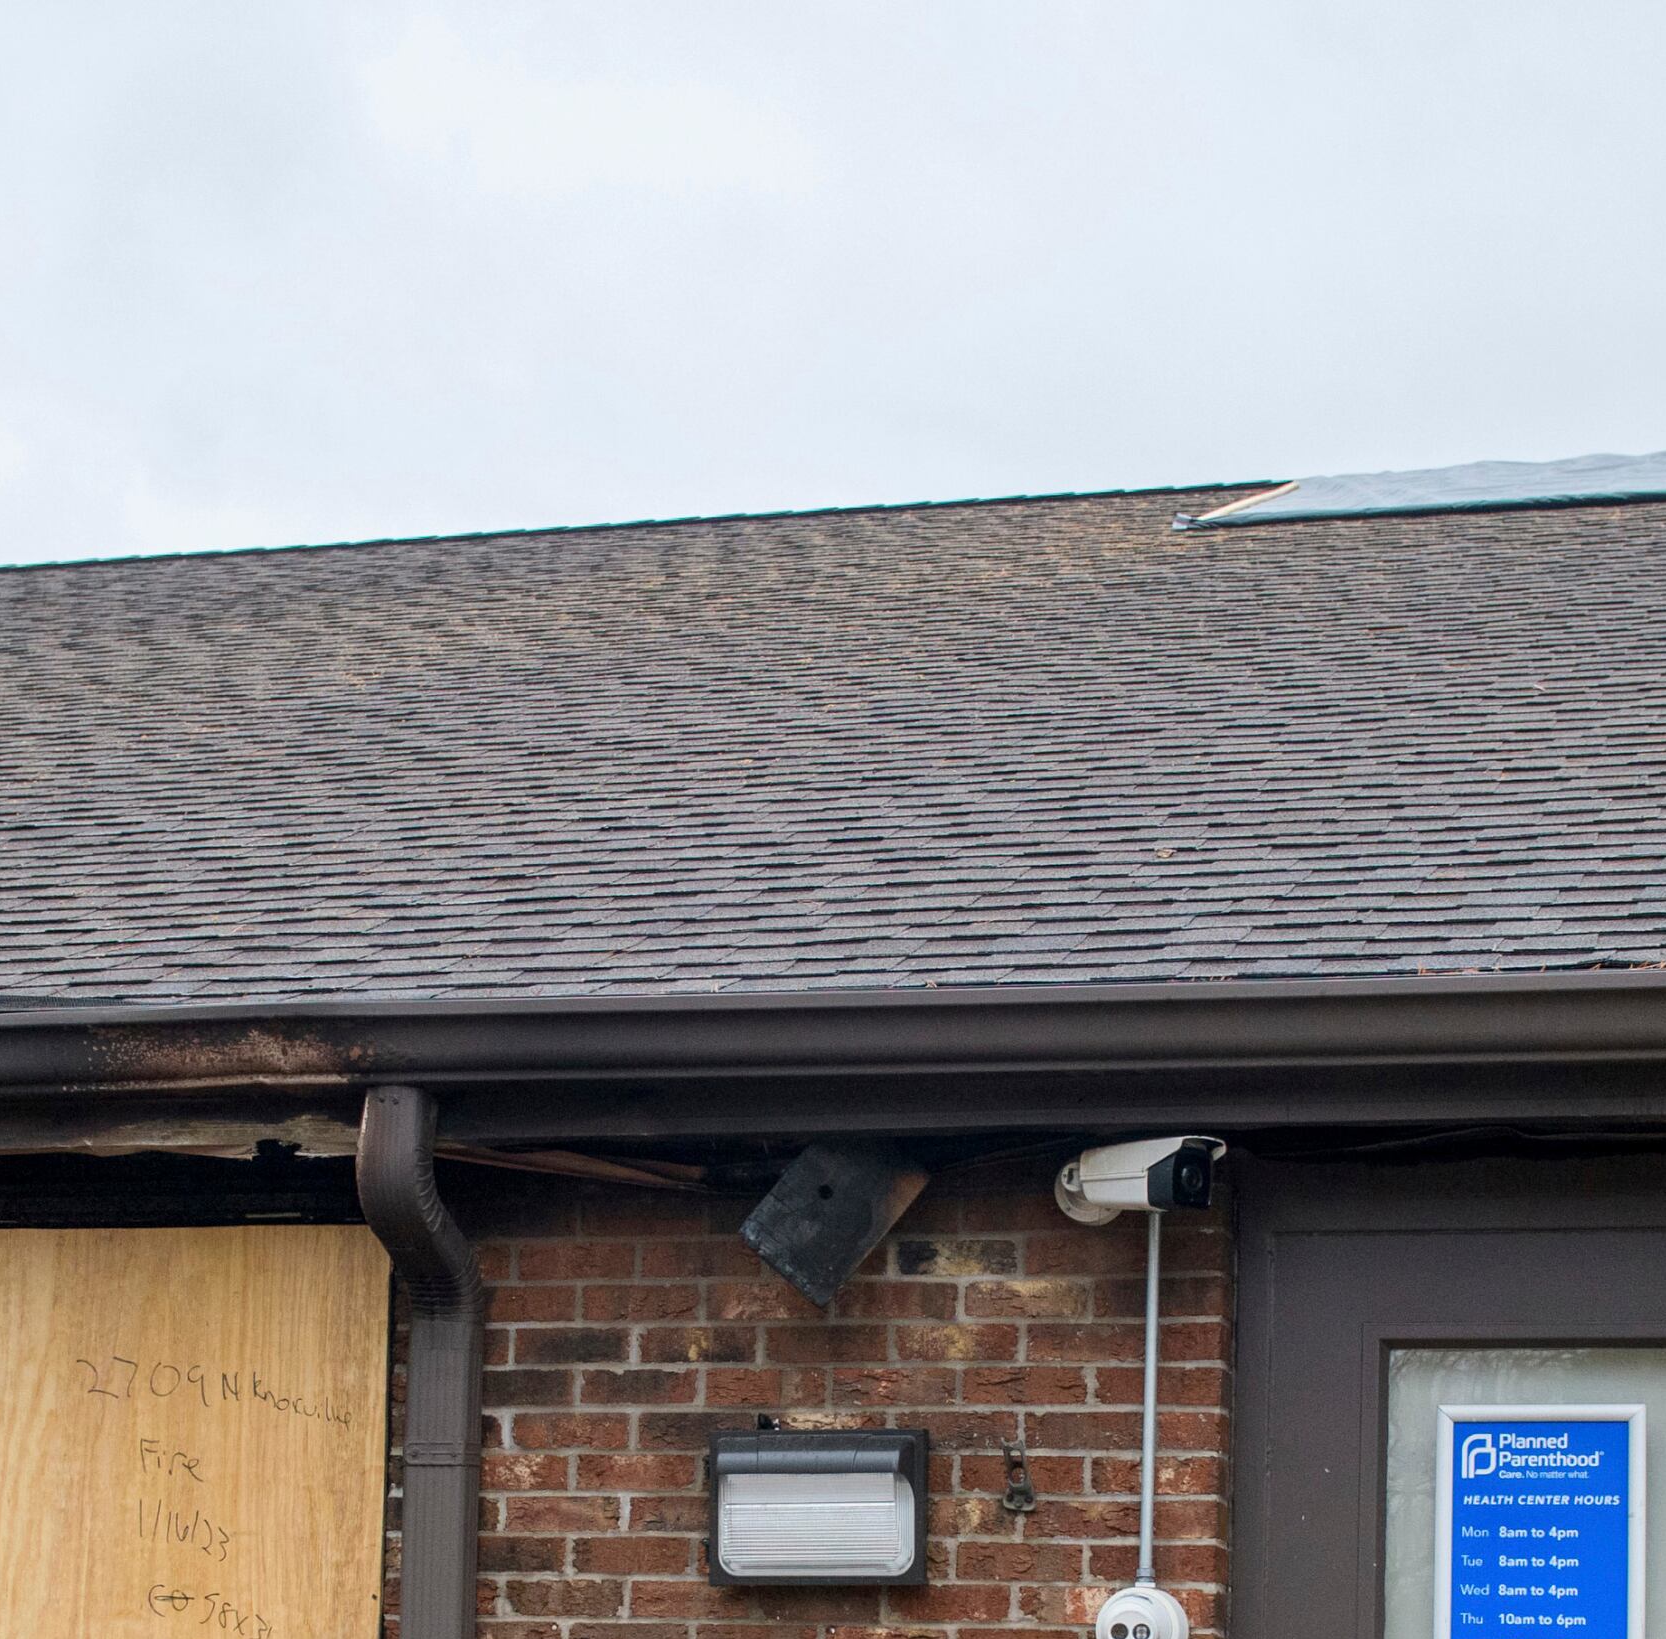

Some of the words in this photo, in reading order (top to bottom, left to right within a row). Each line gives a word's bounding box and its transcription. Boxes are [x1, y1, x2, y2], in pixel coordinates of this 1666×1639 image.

[76, 1355, 210, 1408] 2709
[221, 1371, 240, 1401] N
[1499, 1433, 1568, 1449] Planned
[140, 1438, 203, 1482] Fire
[1499, 1450, 1600, 1467] Parenthood
[1499, 1470, 1525, 1479] Care.
[1526, 1470, 1538, 1479] No
[1540, 1471, 1566, 1479] matter
[1568, 1470, 1589, 1479] what.
[1463, 1495, 1514, 1505] HEALTH
[1518, 1495, 1570, 1506] CENTER
[1574, 1495, 1621, 1506] HOURS
[139, 1499, 230, 1562] 1/16/23
[1461, 1526, 1489, 1538] Mon
[1499, 1526, 1527, 1538] 8am
[1531, 1527, 1545, 1538] to
[1549, 1526, 1579, 1541] 4pm
[1461, 1555, 1483, 1567] Tue
[1499, 1556, 1527, 1568] 8am
[1531, 1557, 1545, 1568] to
[1549, 1557, 1579, 1570] 4pm
[1460, 1584, 1490, 1596] Wed
[1498, 1585, 1527, 1597] 8am
[1531, 1586, 1544, 1597] to
[1549, 1586, 1578, 1600] 4pm
[1460, 1613, 1483, 1625] Thu
[1498, 1614, 1535, 1625] 10am
[1538, 1615, 1552, 1626] to
[1556, 1614, 1586, 1628] 6pm
